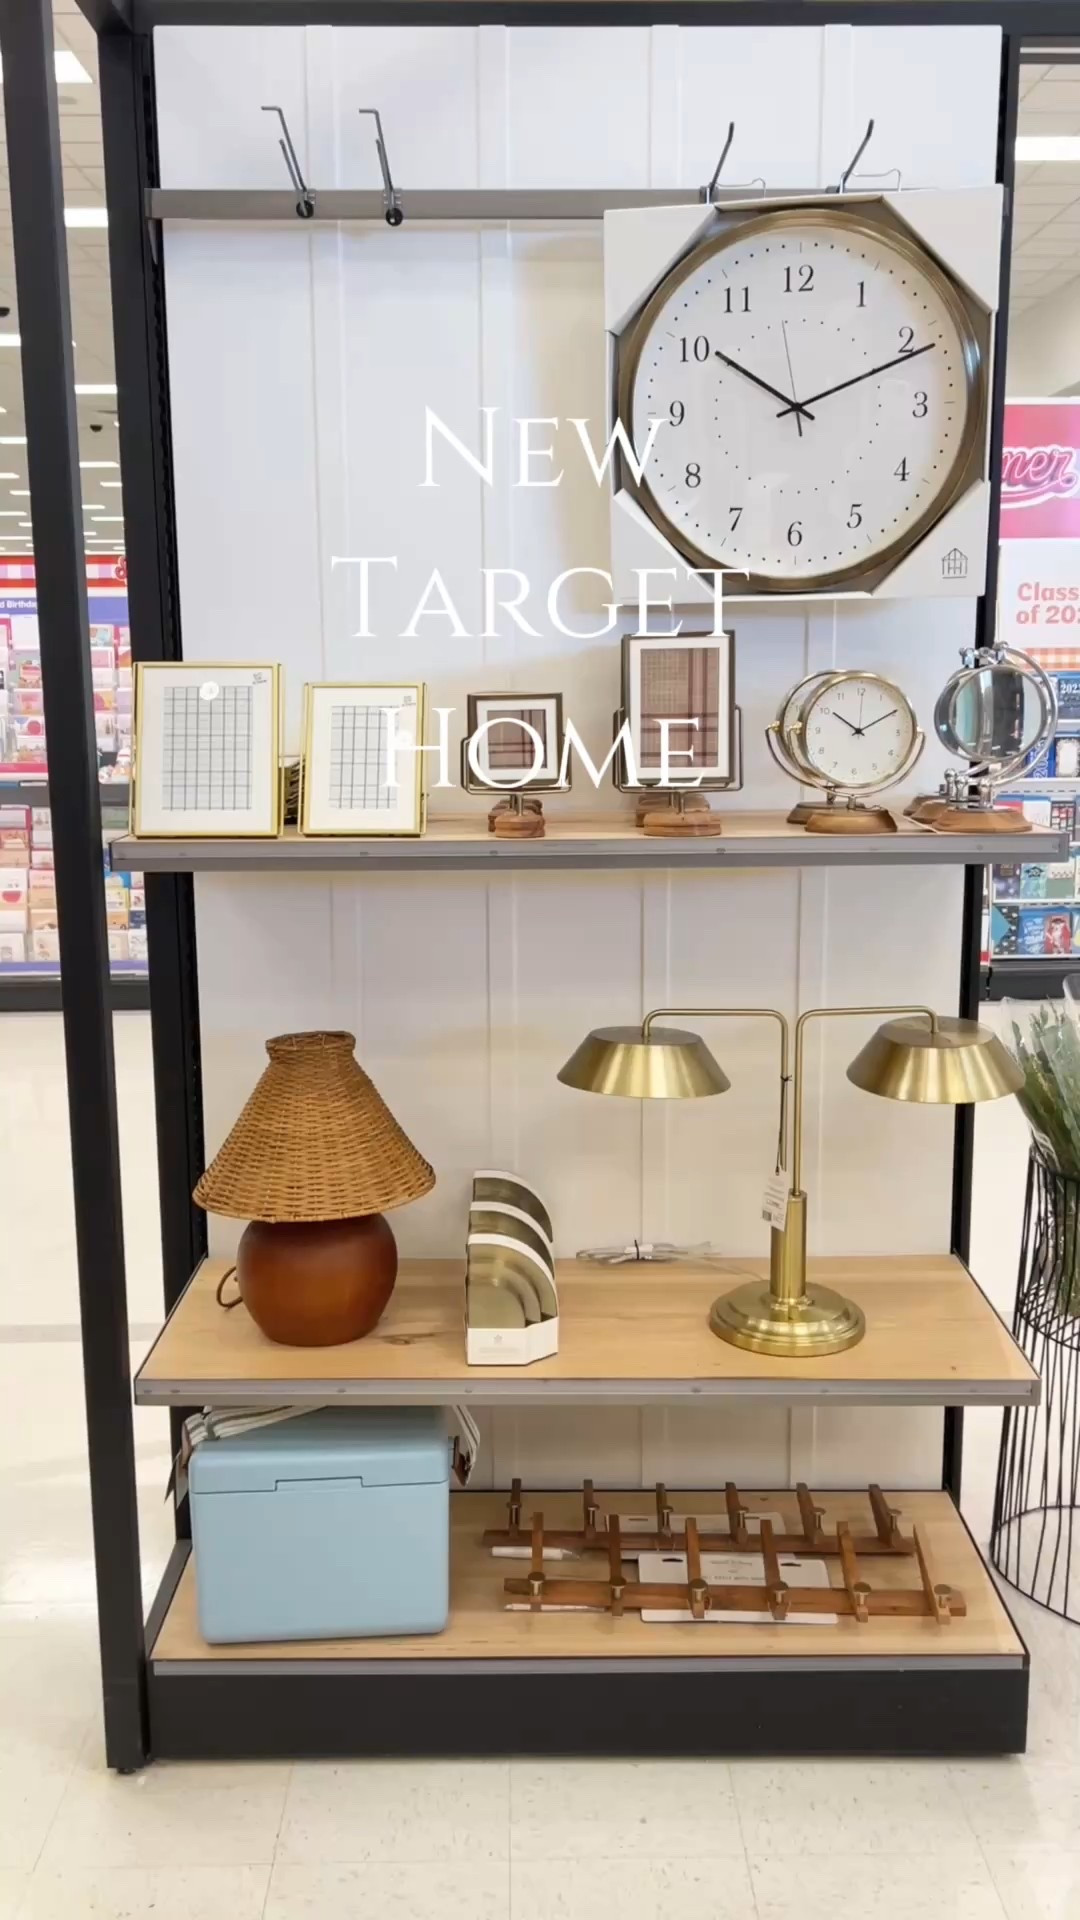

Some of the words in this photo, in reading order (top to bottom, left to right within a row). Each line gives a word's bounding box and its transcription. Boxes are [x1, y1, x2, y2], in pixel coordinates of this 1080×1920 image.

[783, 264, 815, 293] 12
[723, 285, 752, 314] 11
[857, 280, 867, 308] 1
[679, 335, 711, 364] 10
[898, 326, 914, 353] 2
[669, 400, 685, 428] 9
[912, 391, 929, 418] 3
[684, 463, 702, 489] 8
[893, 456, 910, 482] 4
[728, 506, 744, 532] 7
[846, 503, 863, 529] 5
[787, 520, 803, 547] 6
[1016, 604, 1040, 624] of
